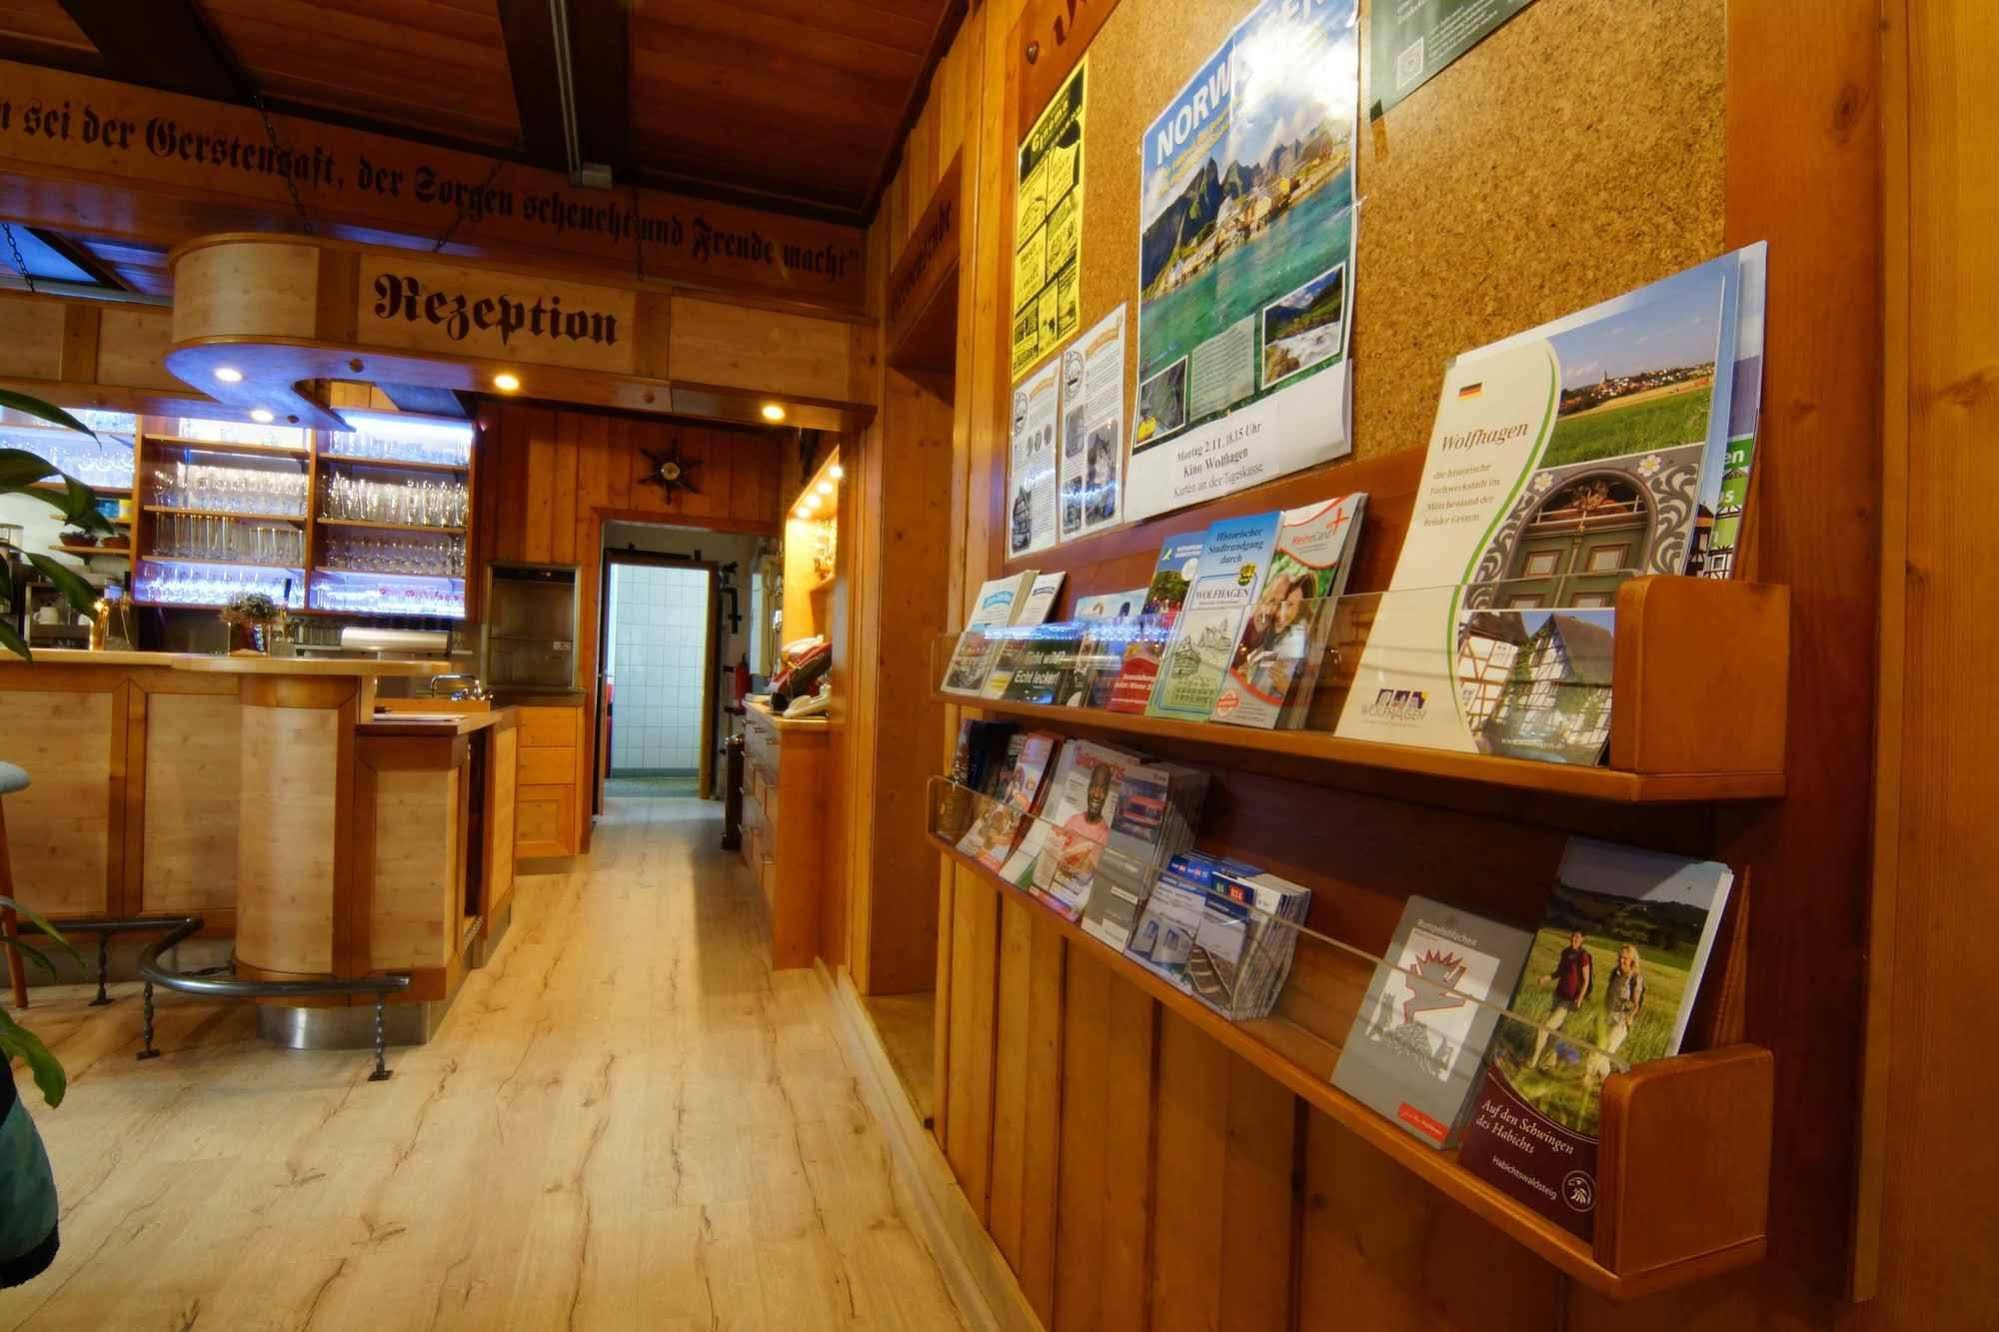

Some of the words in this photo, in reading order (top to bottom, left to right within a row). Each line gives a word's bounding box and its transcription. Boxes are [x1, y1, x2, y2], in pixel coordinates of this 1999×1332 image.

[24, 98, 71, 139] sei
[82, 104, 137, 149] der
[357, 154, 404, 197] der
[415, 164, 514, 222] Sorgen
[374, 273, 619, 346] Rezeption
[1245, 423, 1262, 437] Uhr
[1441, 422, 1529, 452] Wolfhagen
[1184, 464, 1202, 479] Kino
[1205, 448, 1248, 470] Wolfhagen
[1173, 483, 1196, 498] Karten
[1208, 474, 1223, 488] der
[1207, 540, 1265, 554] Stadtrundgang
[1216, 527, 1264, 542] Historischer
[1219, 554, 1243, 565] durch
[1195, 588, 1249, 601] WOLFHAGEN
[1475, 1114, 1490, 1130] des
[1491, 1124, 1536, 1154] Habichts
[1481, 1099, 1503, 1119] Auf
[1500, 1108, 1518, 1126] den
[1519, 1118, 1575, 1155] Schwingen
[1492, 1155, 1558, 1200] Habichtswaldsteig
